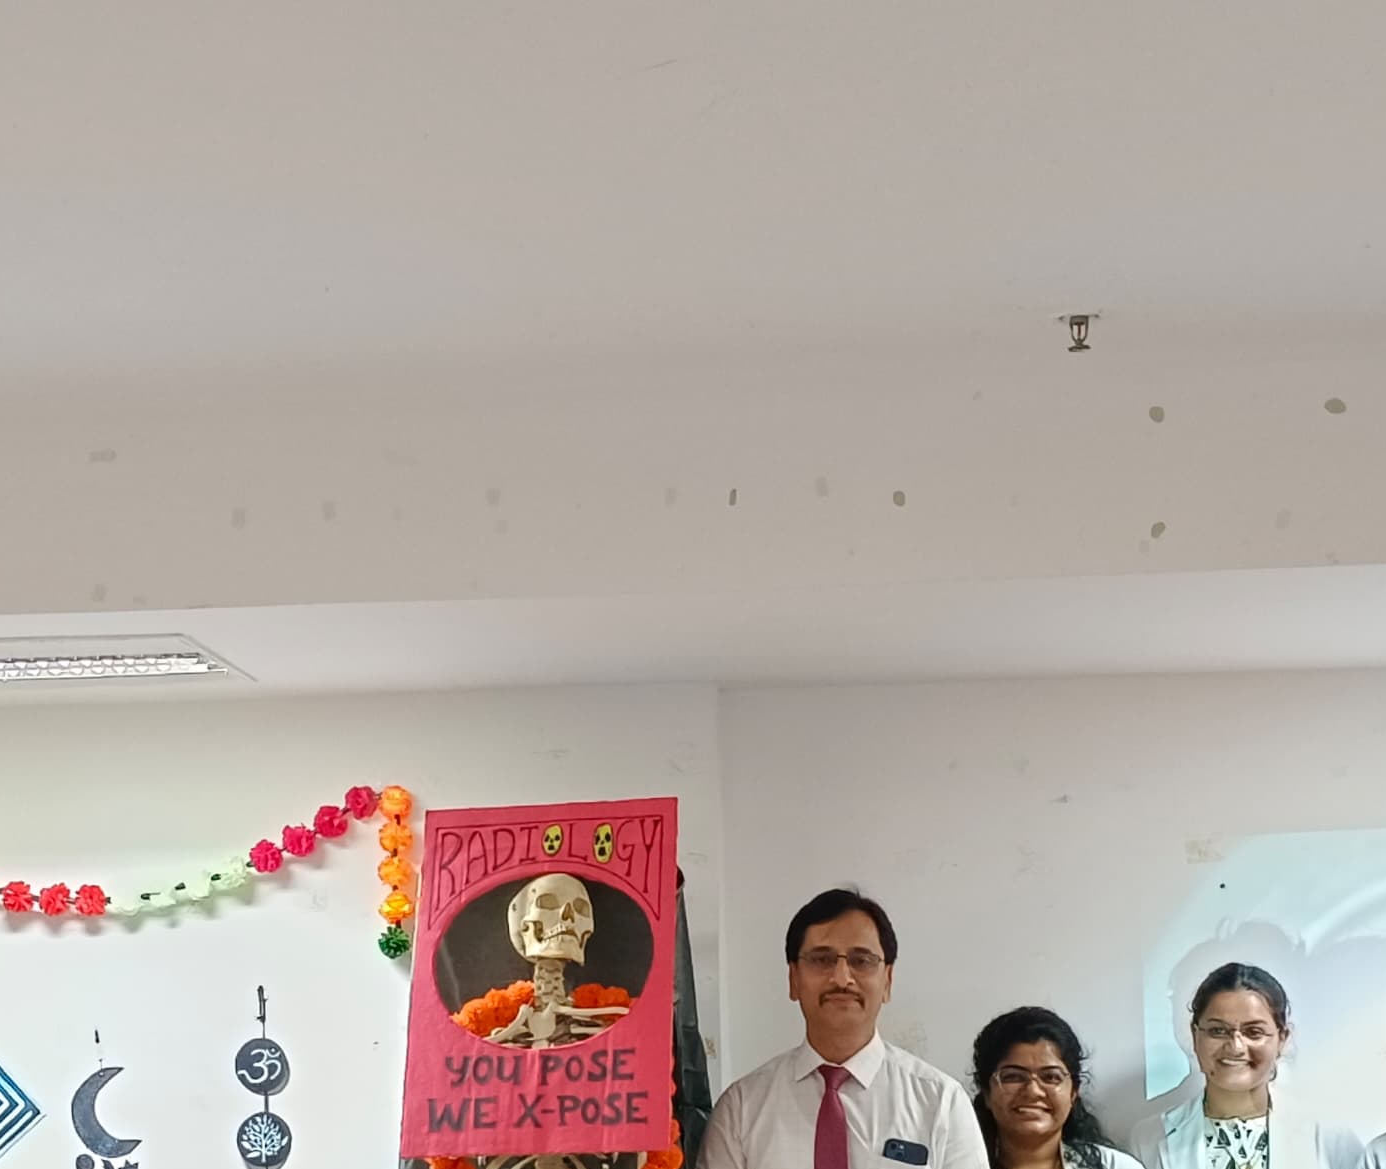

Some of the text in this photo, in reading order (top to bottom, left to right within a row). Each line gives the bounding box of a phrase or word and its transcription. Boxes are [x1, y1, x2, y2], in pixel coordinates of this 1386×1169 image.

[435, 818, 661, 911] RADIOLOGY
[445, 1048, 636, 1088] YOU POSE
[427, 1092, 649, 1134] WE X-POSE
